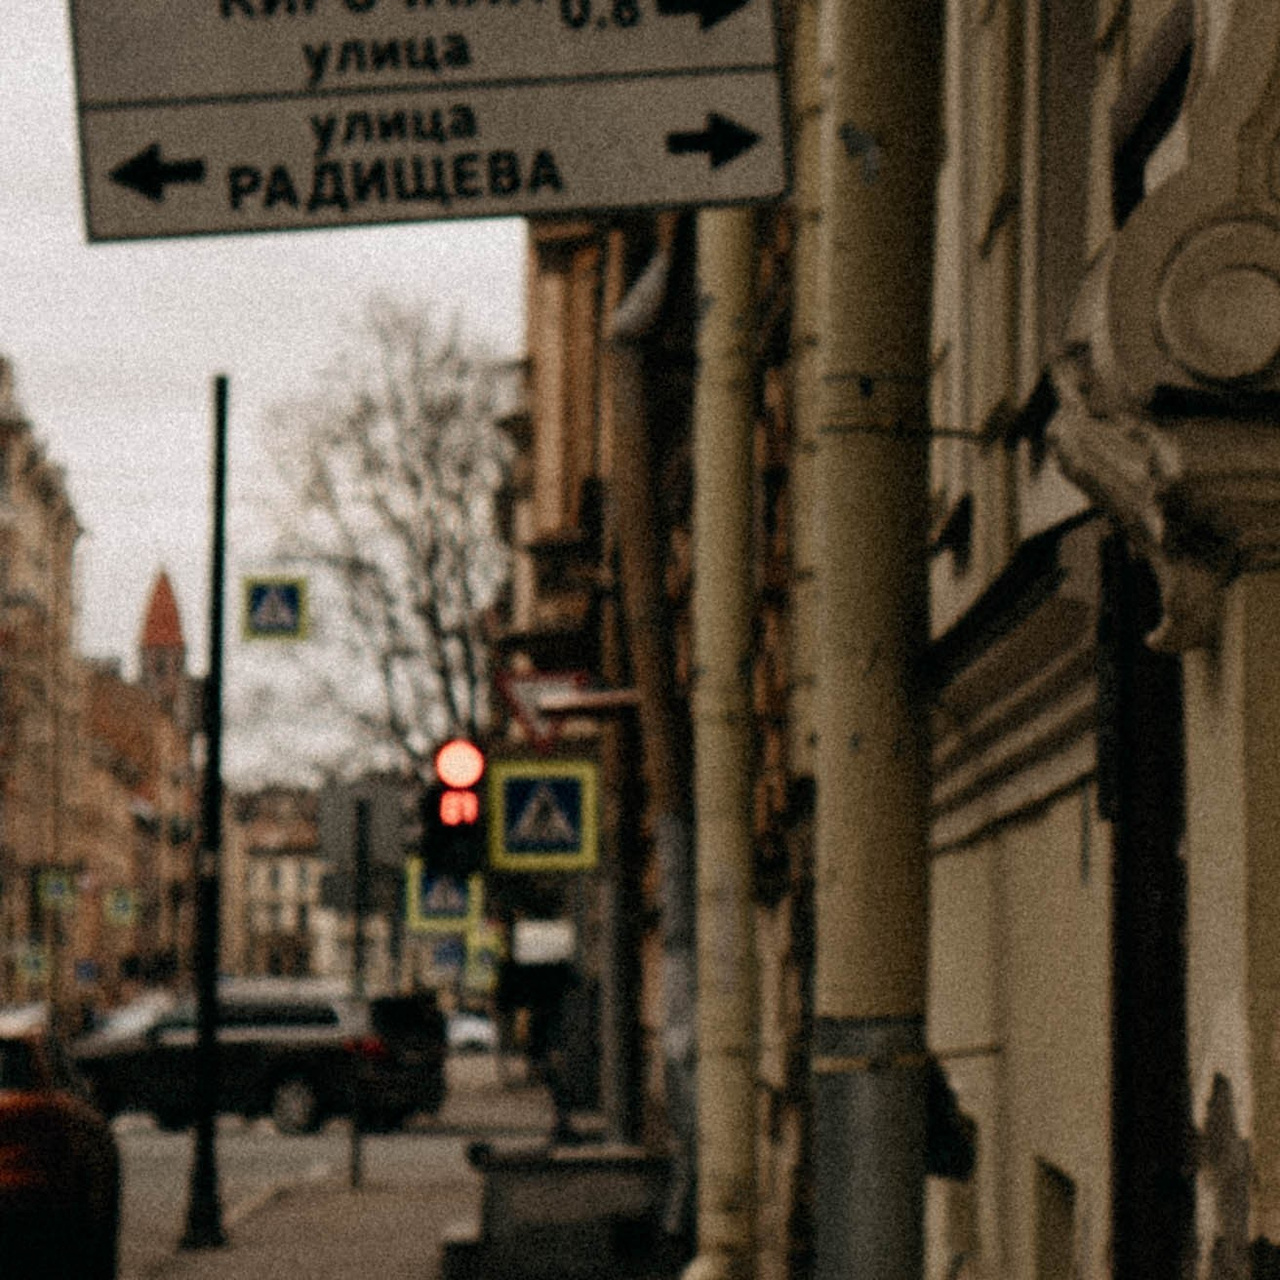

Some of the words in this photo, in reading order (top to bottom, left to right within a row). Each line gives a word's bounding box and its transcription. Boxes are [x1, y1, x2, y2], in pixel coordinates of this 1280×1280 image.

[302, 33, 471, 88] улица
[311, 103, 477, 158] улица
[228, 149, 564, 213] РАДИЩЕВА
